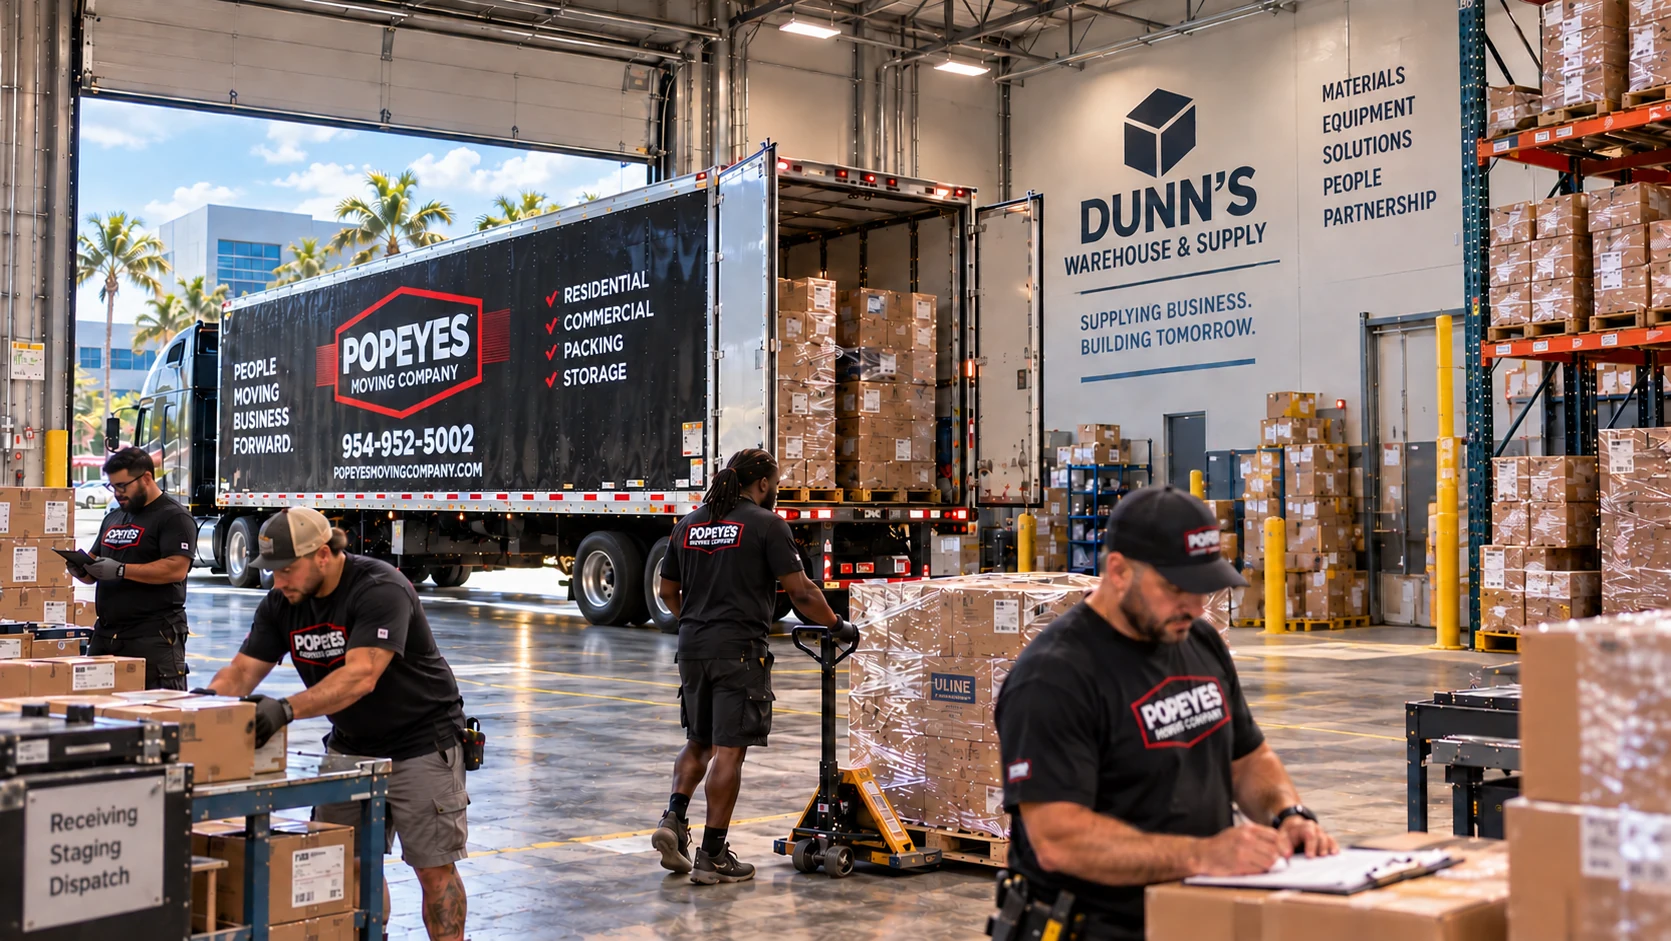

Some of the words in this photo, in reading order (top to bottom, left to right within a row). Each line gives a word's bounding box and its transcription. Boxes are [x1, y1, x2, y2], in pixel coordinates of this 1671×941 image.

[1322, 65, 1405, 103] MATERIALS
[1323, 95, 1416, 134] EQUIPMENT
[1323, 129, 1412, 165] SOLUTIONS
[1324, 167, 1382, 196] PEOPLE
[1081, 166, 1257, 244] DUNN'S
[1324, 190, 1437, 228] PARTNERSHIP
[1064, 239, 1172, 276] WAREHOUSE
[1177, 236, 1191, 257] &
[1196, 221, 1267, 254] SUPPLY
[564, 270, 650, 304] RESIDENTIAL
[564, 299, 655, 331] COMMERCIAL
[1080, 303, 1162, 331] SUPPLYING
[1167, 291, 1252, 319] BUSINESS.
[343, 313, 470, 375] POPEYES
[564, 333, 624, 359] PACKING
[1081, 331, 1152, 356] BUILDING
[1156, 317, 1256, 347] TOMORROW.
[234, 356, 277, 381] PEOPLE
[351, 373, 395, 395] MOVING
[398, 363, 459, 387] COMPANY
[563, 362, 627, 387] STORAGE
[234, 382, 280, 407] MOVING
[233, 406, 289, 430] BUSINESS
[233, 433, 294, 455] FORWARD.
[342, 423, 475, 459] 954-952-5002
[689, 525, 739, 540] POPEYES
[934, 677, 971, 694] ULINE
[1140, 682, 1223, 730] POPEYES
[50, 804, 138, 834] Receiving
[50, 838, 121, 865] Staging
[50, 865, 130, 898] Dispatch
